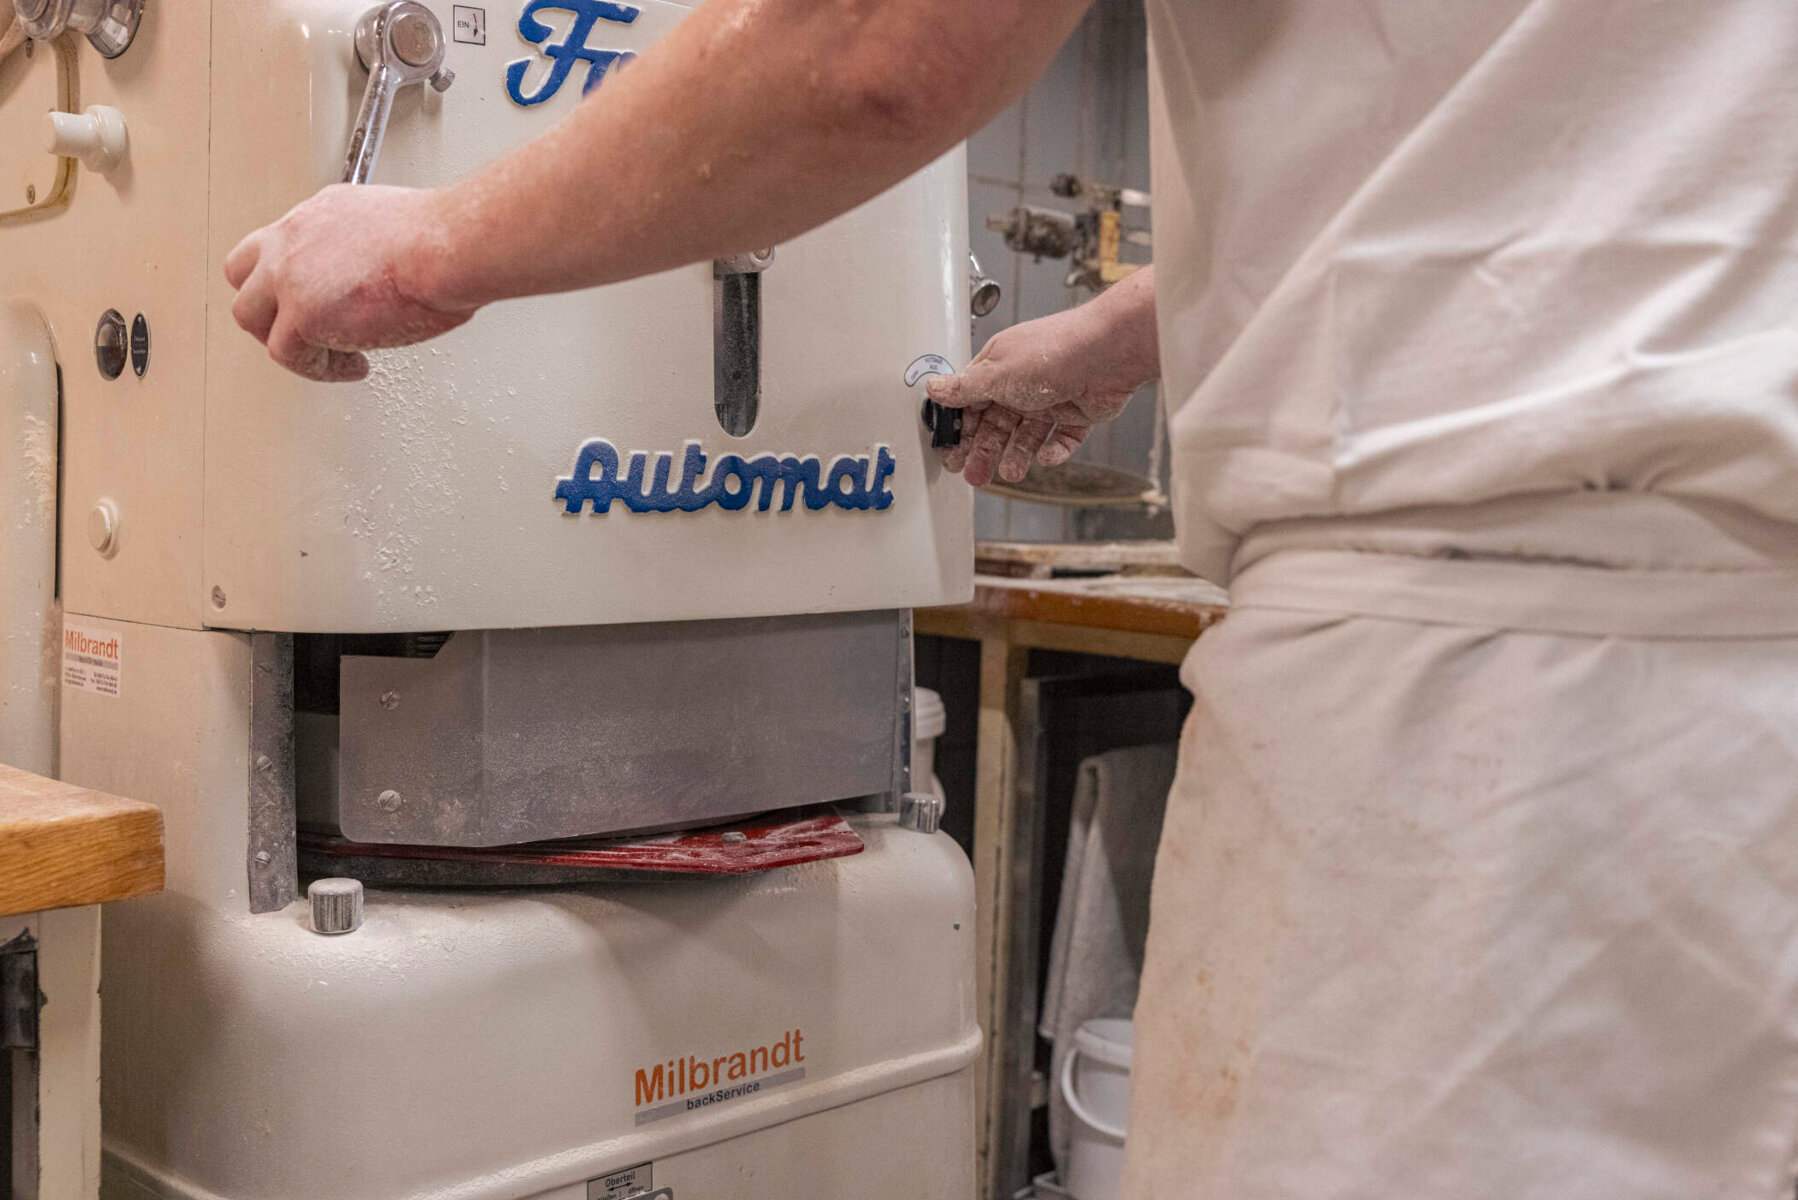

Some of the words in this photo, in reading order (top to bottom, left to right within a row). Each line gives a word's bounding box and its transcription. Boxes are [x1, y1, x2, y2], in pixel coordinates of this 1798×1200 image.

[457, 20, 470, 29] EIN
[554, 438, 896, 514] Automat
[65, 629, 119, 660] Milbrandt
[635, 1029, 806, 1107] Milbrandt
[686, 1081, 760, 1111] backService
[605, 1170, 637, 1188] Oberteil
